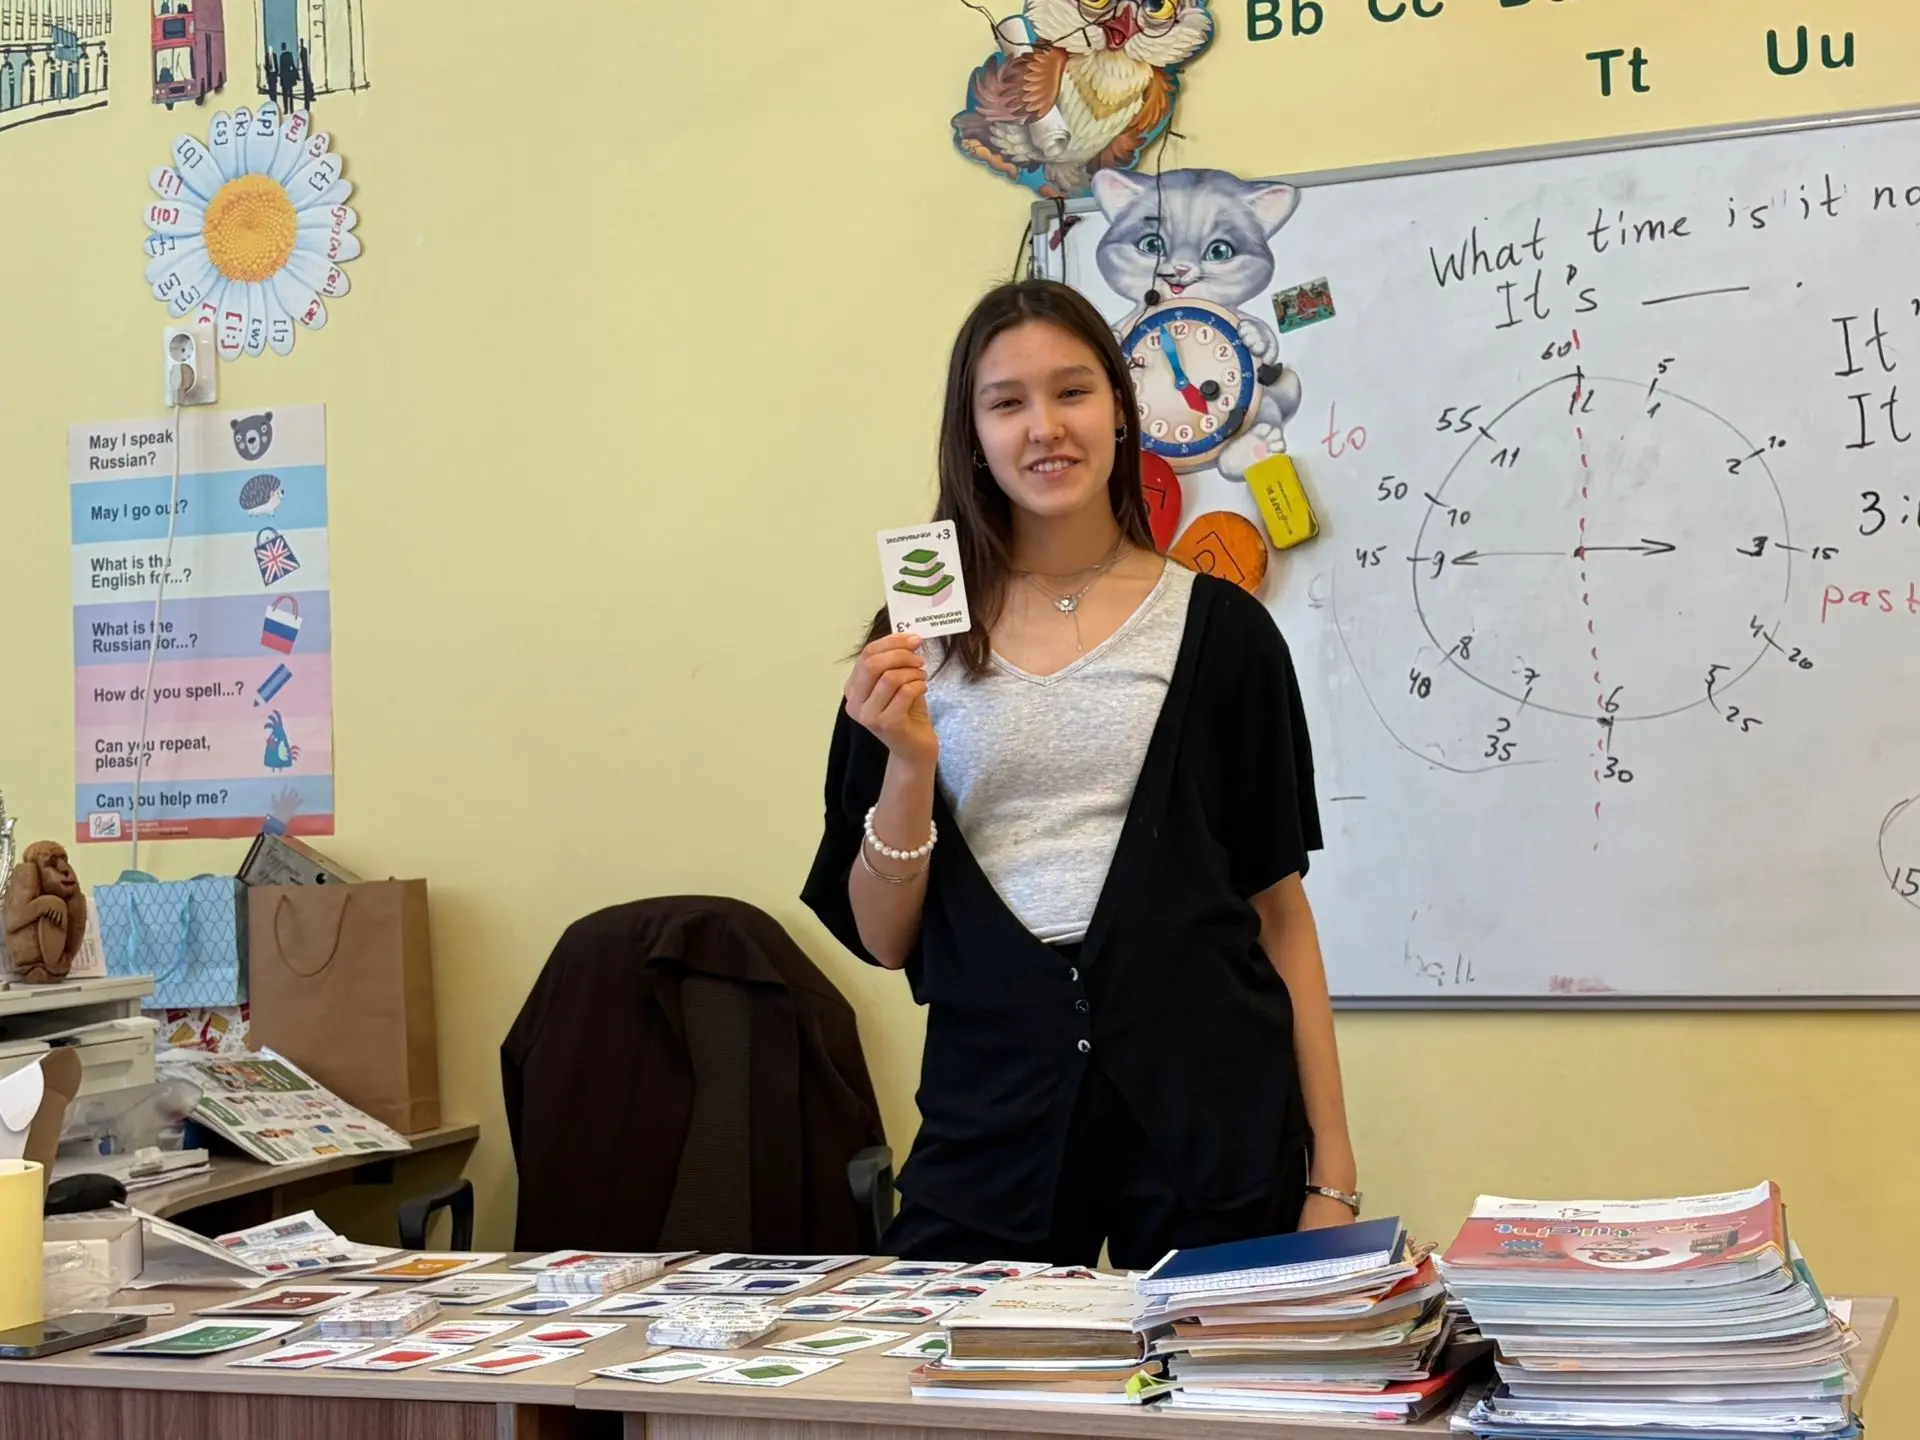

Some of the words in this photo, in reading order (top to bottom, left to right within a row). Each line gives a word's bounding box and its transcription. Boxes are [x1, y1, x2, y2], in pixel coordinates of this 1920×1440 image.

[1246, 0, 1323, 42] Bb
[1767, 26, 1856, 75] Uu
[1586, 47, 1650, 97] Tt
[1430, 217, 1546, 287] What
[1587, 208, 1691, 253] time
[1728, 197, 1768, 229] is
[1495, 264, 1598, 329] It's
[1174, 324, 1187, 336] 12
[1201, 329, 1208, 340] 1
[1219, 346, 1228, 357] 2
[1227, 371, 1236, 382] 3
[1222, 397, 1229, 407] 4
[1155, 422, 1163, 433] 7
[1205, 418, 1213, 429] 5
[1436, 405, 1481, 433] 55
[89, 434, 117, 451] May
[122, 432, 126, 447] I
[130, 429, 174, 448] speak
[1179, 428, 1188, 439] 6
[1322, 402, 1366, 458] to
[89, 451, 157, 471] Russian?
[1377, 476, 1409, 501] 50
[91, 505, 119, 523] May
[124, 503, 128, 518] I
[132, 504, 151, 521] go
[1447, 509, 1471, 527] 10
[936, 529, 951, 540] +3
[91, 556, 128, 572] What
[132, 555, 144, 569] is
[1356, 546, 1387, 568] 45
[1430, 551, 1445, 579] 9
[91, 571, 146, 591] English
[92, 622, 129, 637] What
[134, 621, 145, 635] is
[93, 638, 150, 653] Russian
[94, 687, 125, 703] How
[153, 687, 181, 704] you
[185, 681, 244, 699] spell...?
[1723, 706, 1763, 733] 25
[96, 739, 123, 754] Can
[160, 735, 211, 755] repeat,
[1484, 735, 1517, 762] 35
[1603, 757, 1634, 783] 30
[96, 794, 124, 808] Can
[160, 791, 191, 809] help
[196, 789, 228, 805] me?
